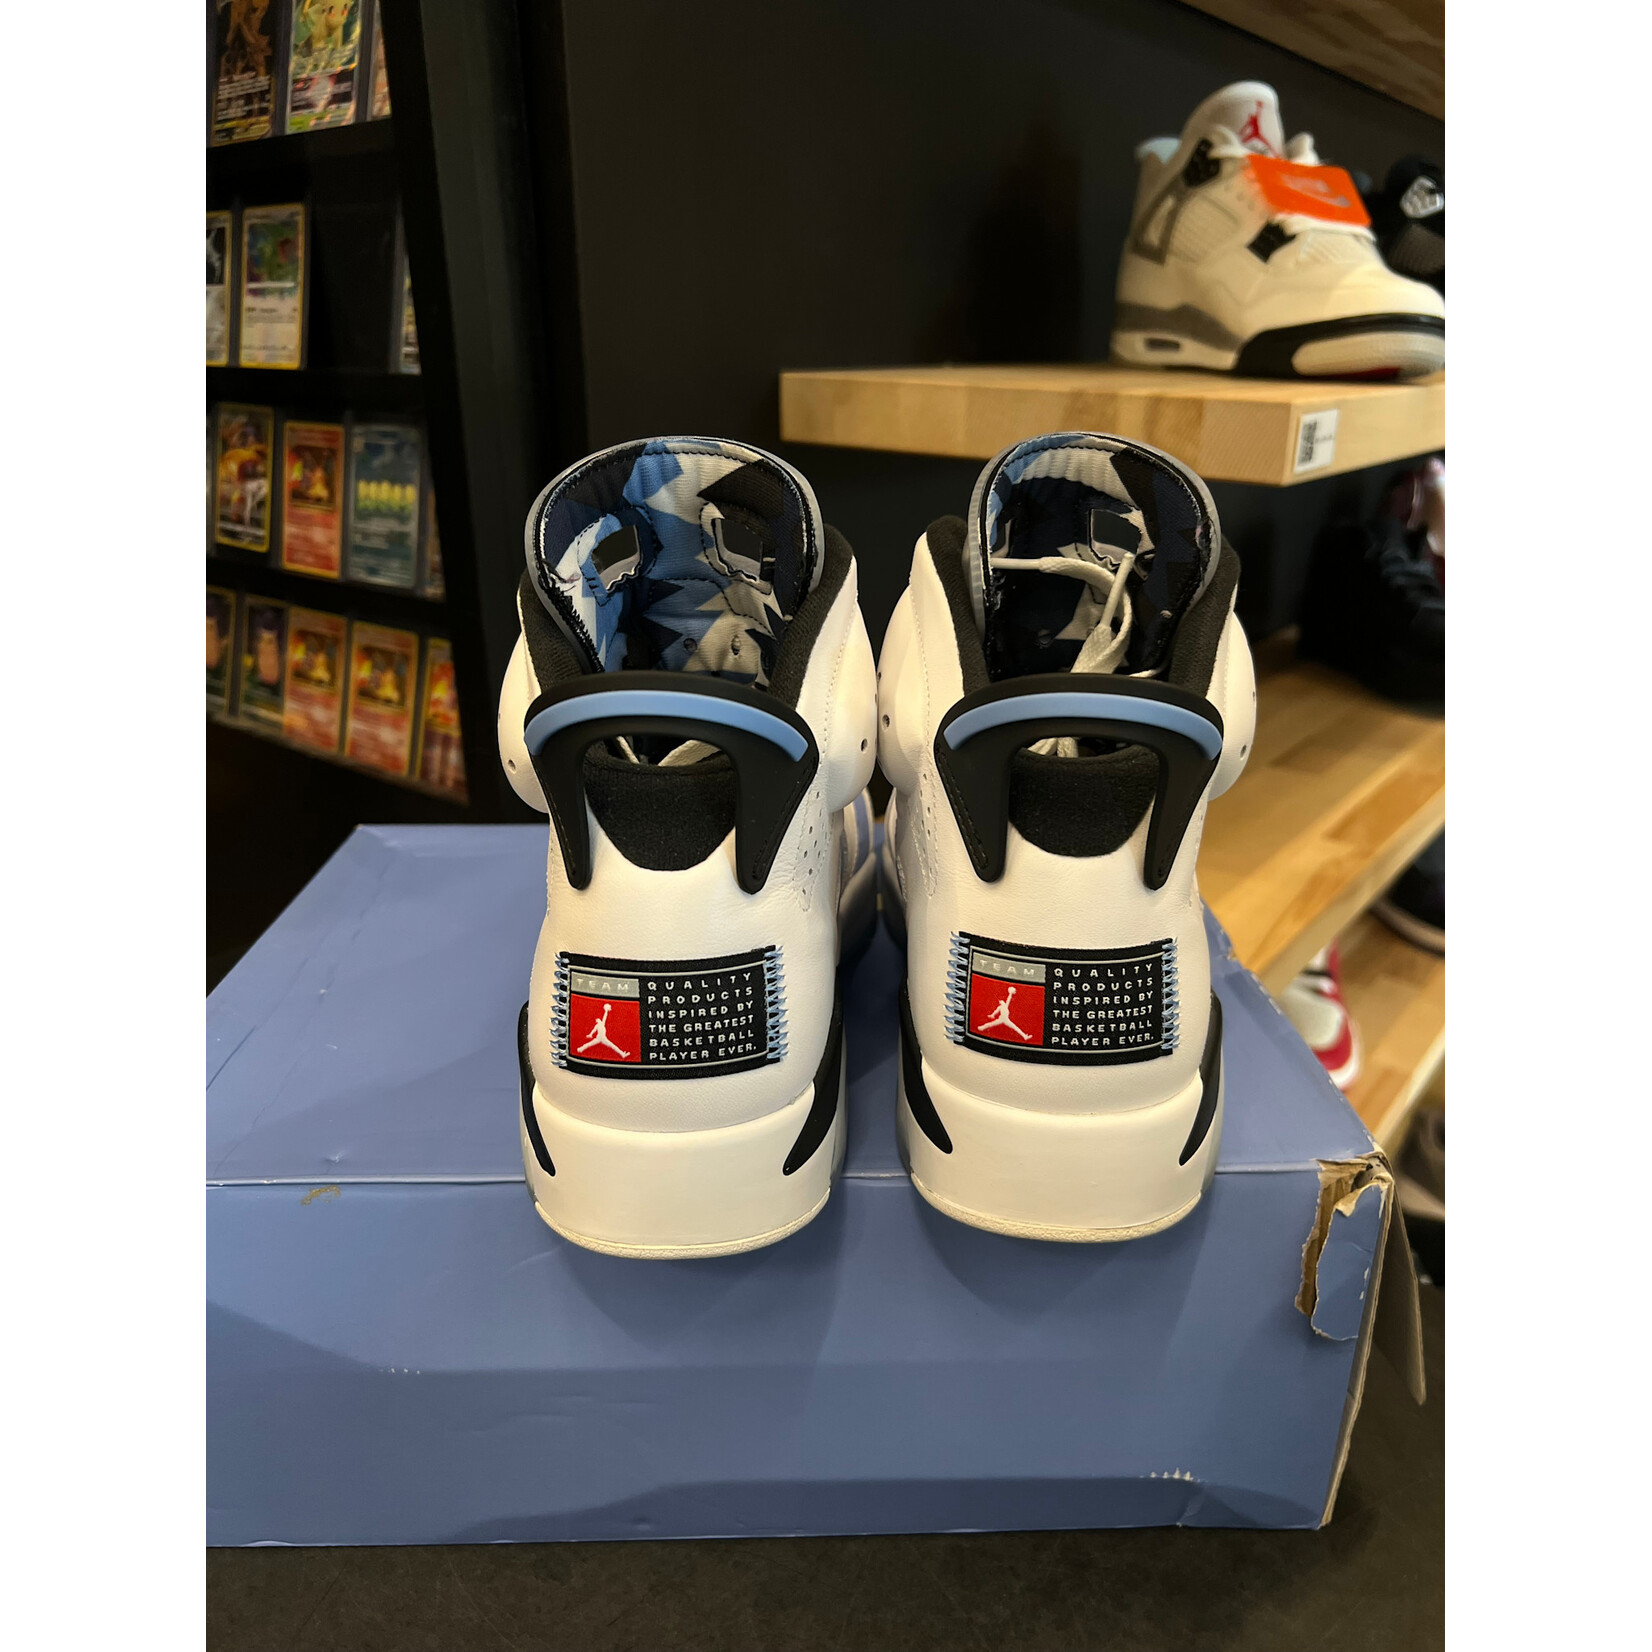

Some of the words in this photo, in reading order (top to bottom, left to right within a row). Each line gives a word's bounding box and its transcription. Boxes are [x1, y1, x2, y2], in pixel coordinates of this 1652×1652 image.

[979, 959, 1035, 976] TEAM
[1053, 963, 1153, 978] QUALITY
[577, 978, 629, 993] TEAM
[647, 972, 752, 991] QUALITY
[1053, 977, 1153, 991] PRODUCTS
[647, 986, 753, 1005] PRODUCTS
[1053, 995, 1131, 1006] INSPIRED
[1138, 990, 1154, 1002] BY
[648, 1005, 728, 1019] INSPIRED
[737, 1000, 754, 1012] BY
[1053, 1010, 1080, 1019] THE
[1086, 1004, 1153, 1020] GREATEST
[649, 1024, 677, 1033] THE
[683, 1014, 754, 1032] GREATEST
[1052, 1020, 1152, 1032] BASKETBALL
[649, 1029, 754, 1047] BASKETBALL
[1051, 1036, 1111, 1046] PLAYER
[1118, 1032, 1154, 1045] EVER.
[649, 1050, 709, 1061] PLAYER
[718, 1043, 757, 1056] EVER.
